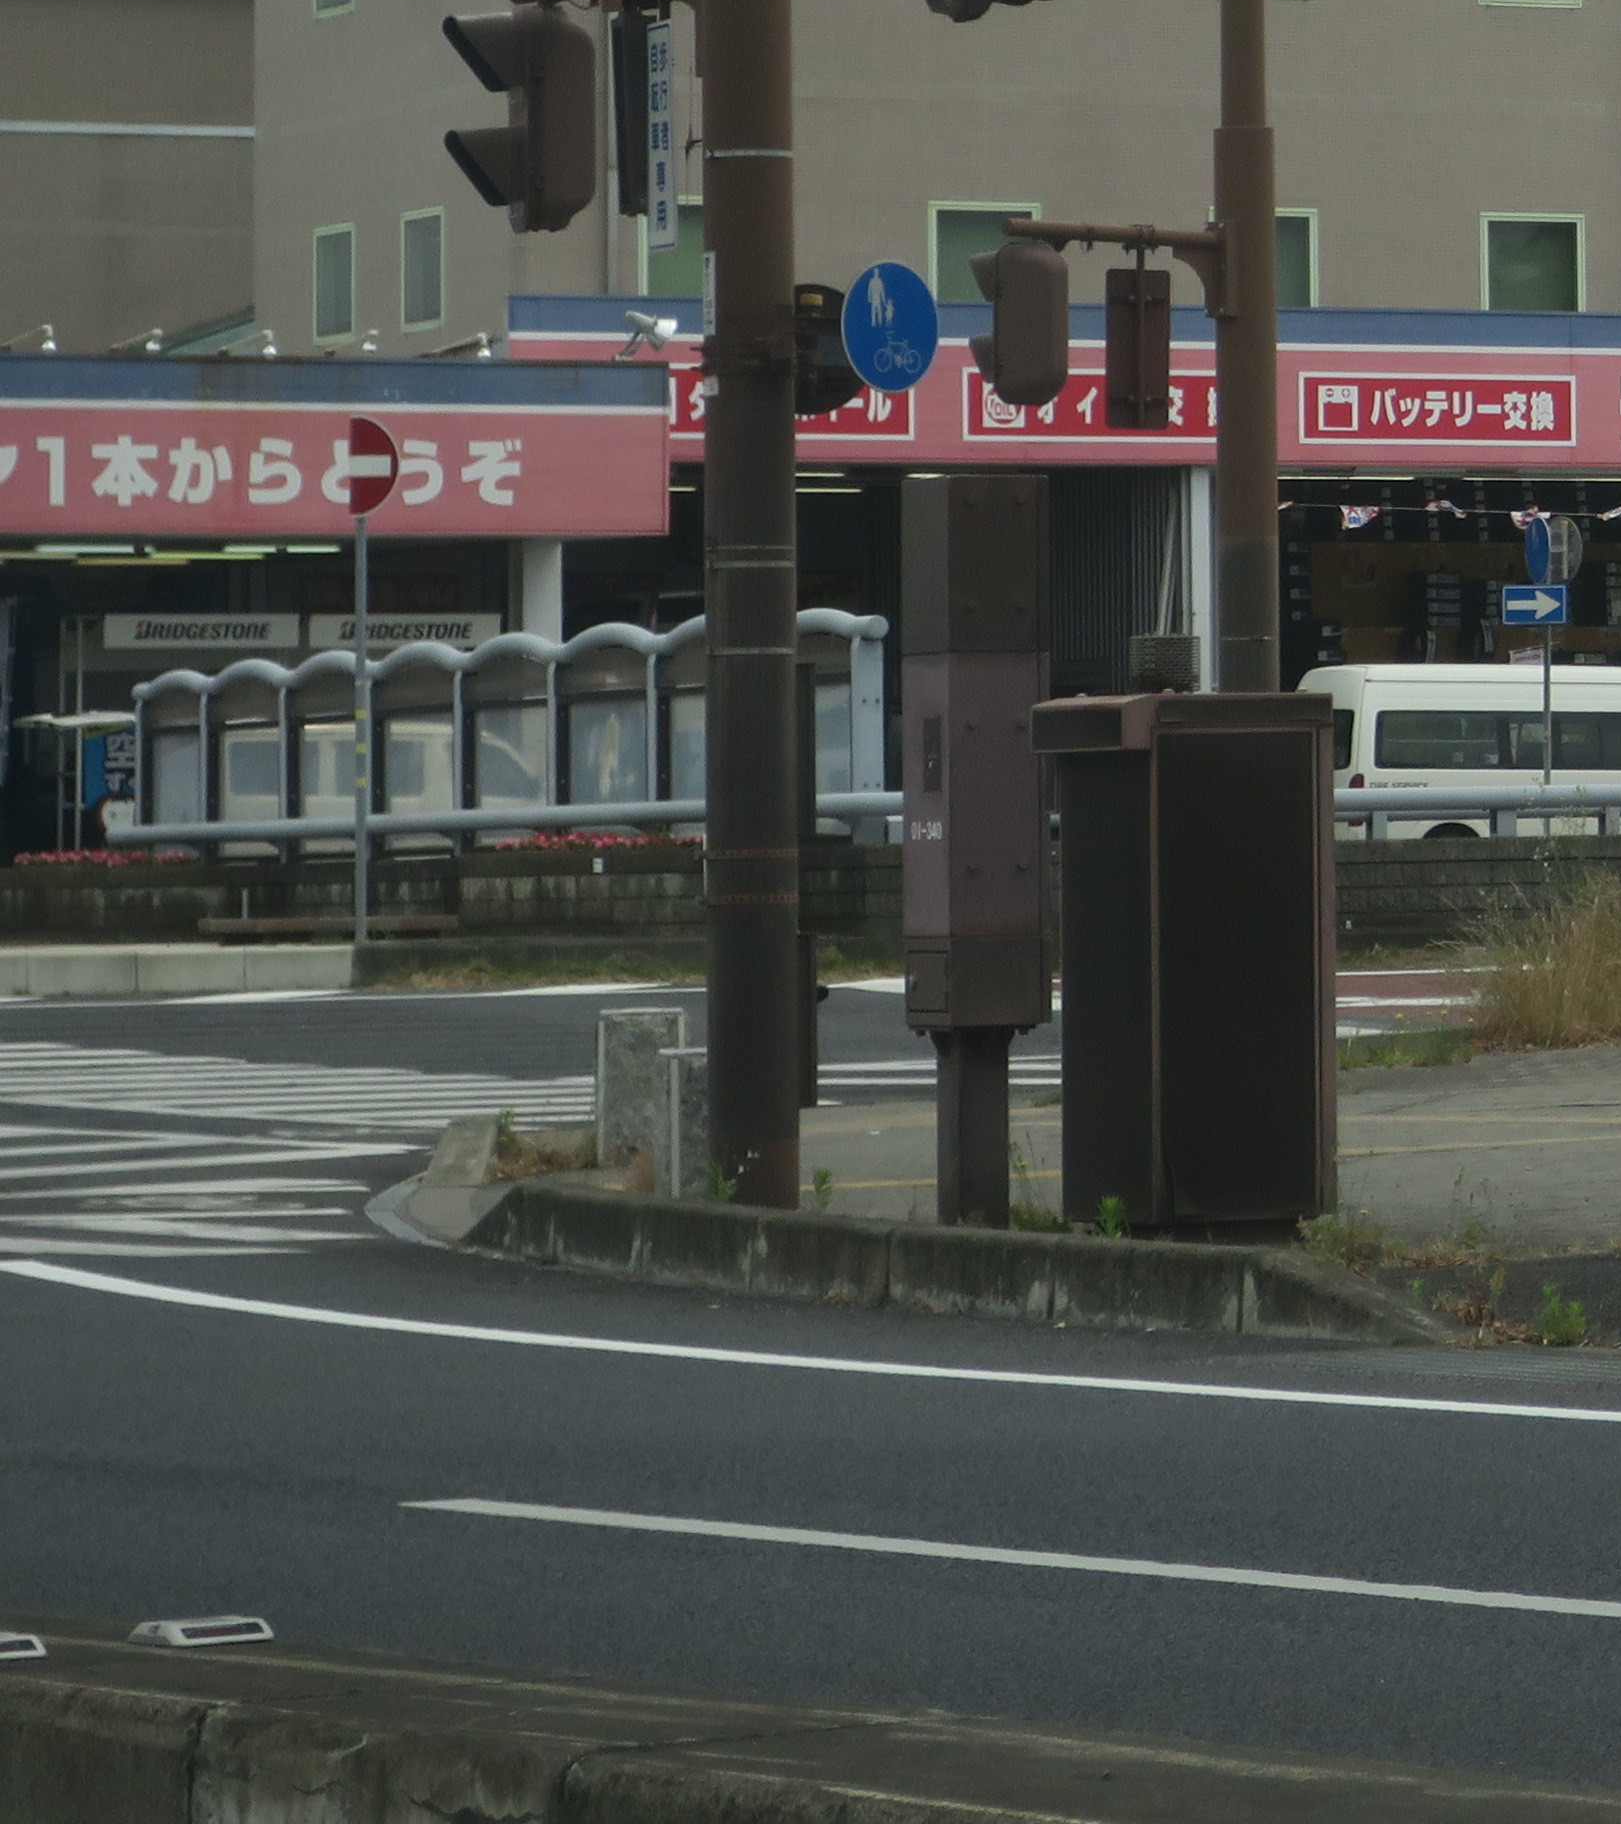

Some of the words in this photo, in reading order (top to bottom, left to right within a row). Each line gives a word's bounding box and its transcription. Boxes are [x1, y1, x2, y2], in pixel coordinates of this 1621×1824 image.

[1370, 387, 1555, 431] バッテリー交換
[133, 621, 271, 642] BRIDGESTONE
[338, 621, 472, 642] BIDGESTONE
